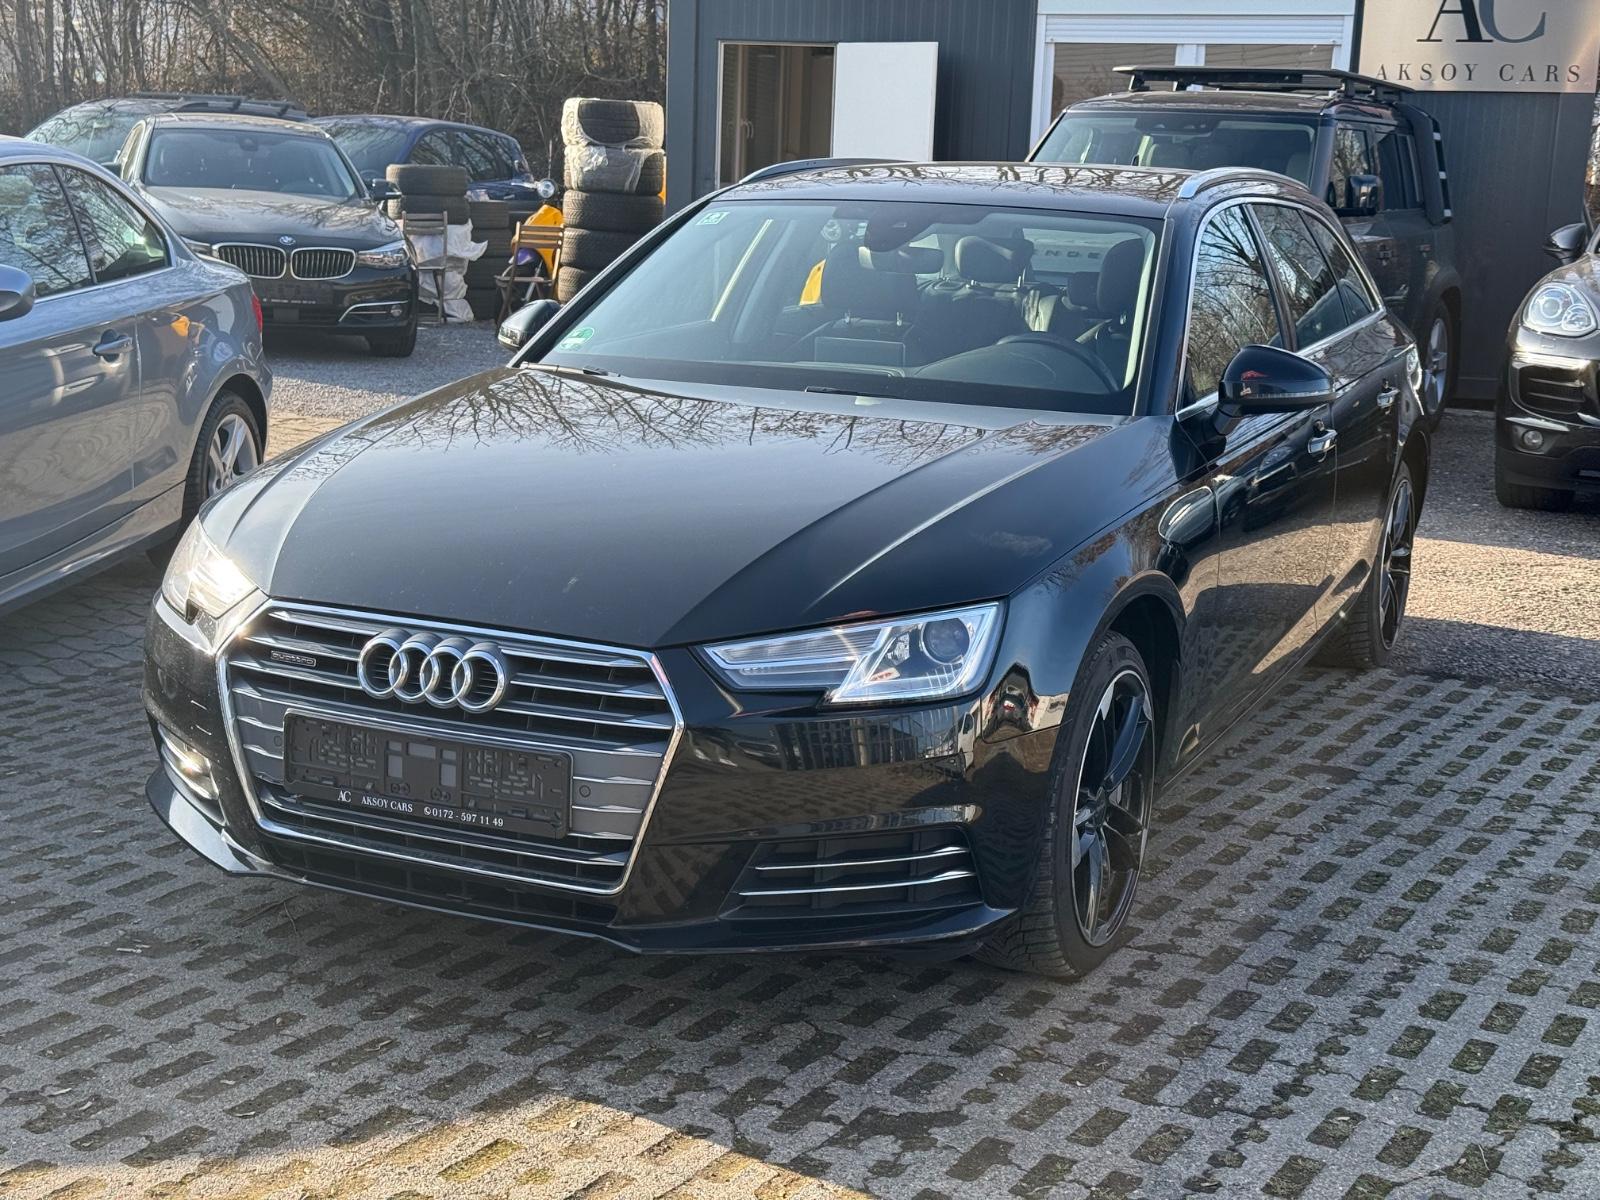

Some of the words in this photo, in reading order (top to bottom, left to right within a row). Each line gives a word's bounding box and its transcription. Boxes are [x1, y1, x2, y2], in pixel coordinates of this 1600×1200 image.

[1416, 0, 1547, 43] AC
[1376, 63, 1479, 81] AKSOY
[1499, 64, 1581, 82] CARS
[337, 790, 351, 802] AC
[361, 796, 389, 809] AKSOY
[390, 800, 413, 813] CARS
[432, 808, 454, 819] 0172
[460, 812, 477, 823] 597
[480, 816, 490, 825] 11
[492, 817, 504, 827] 49
